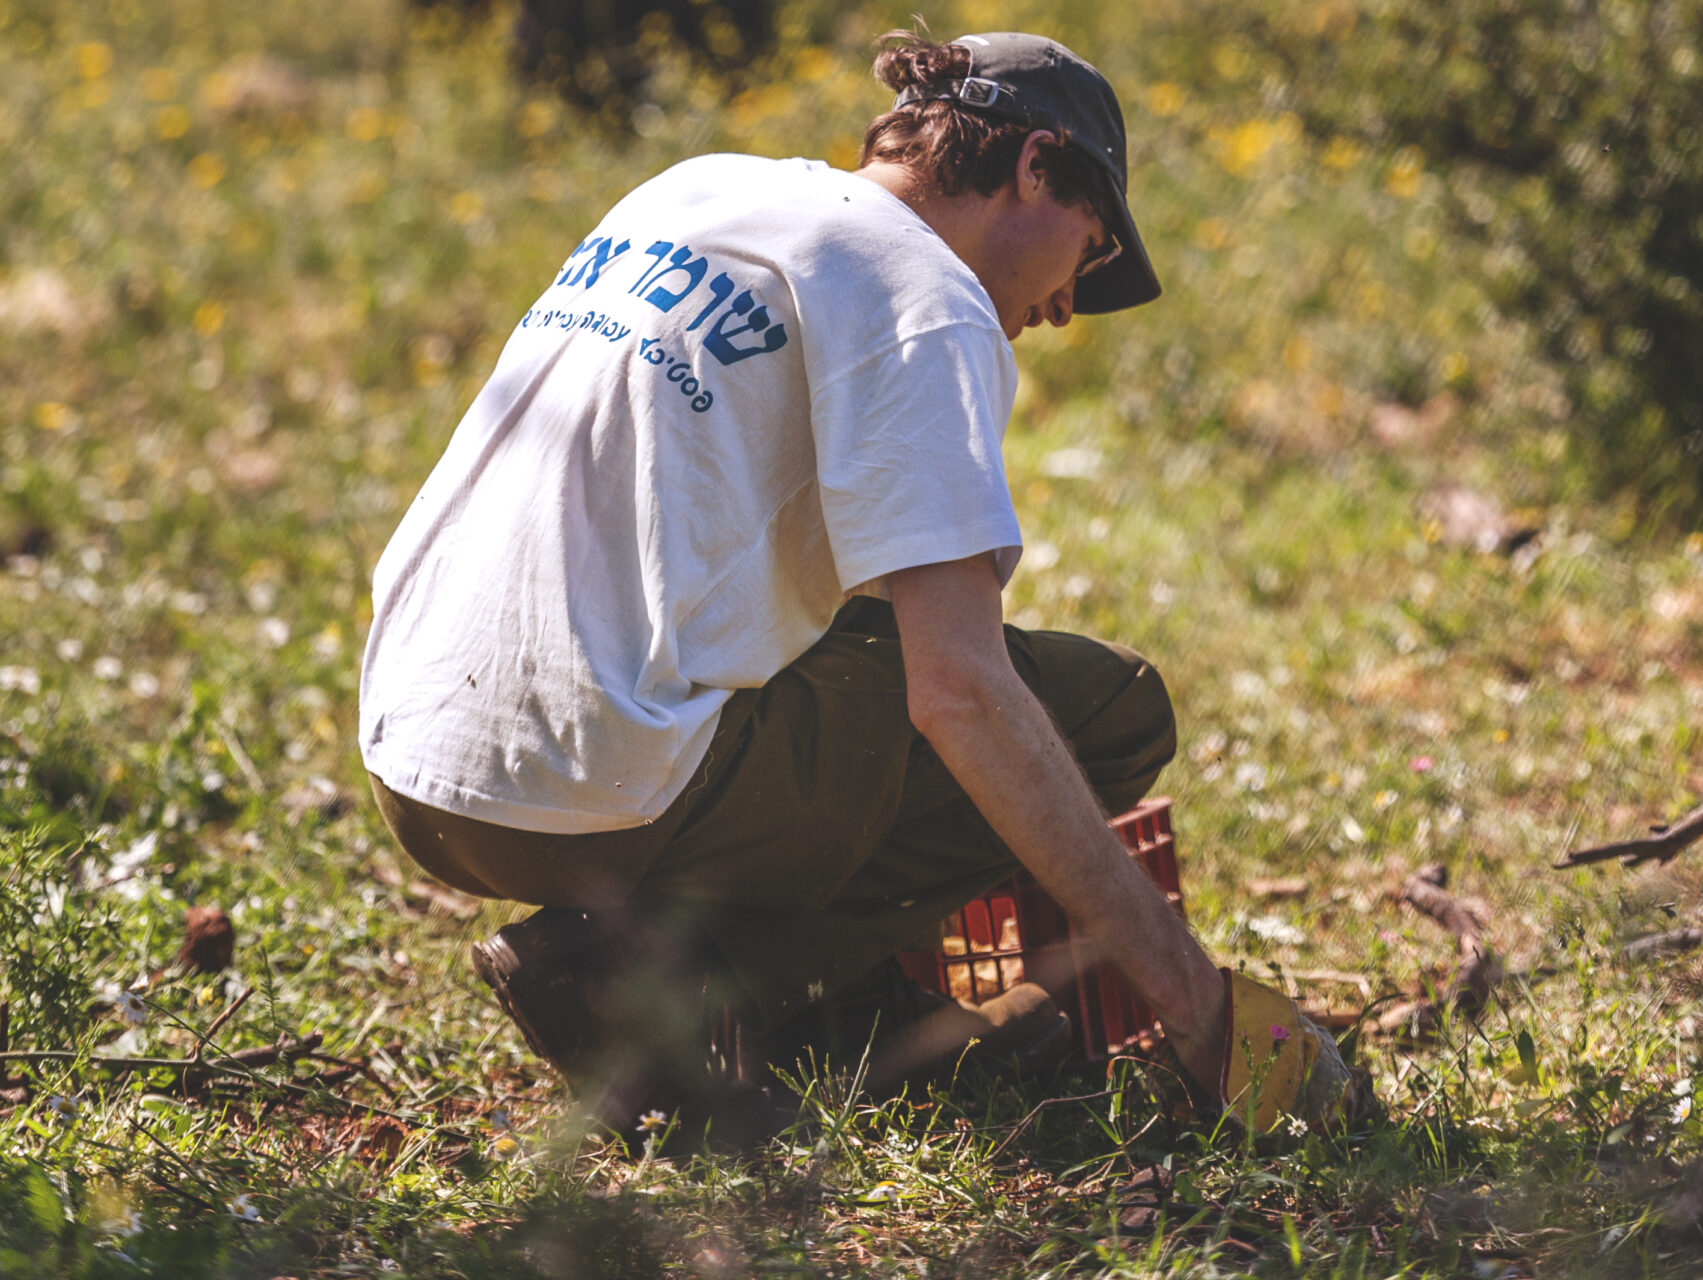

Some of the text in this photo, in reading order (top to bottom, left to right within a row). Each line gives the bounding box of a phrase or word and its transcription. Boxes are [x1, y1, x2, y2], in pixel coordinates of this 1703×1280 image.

[580, 310, 632, 343] עבודה
[628, 240, 788, 366] שומר
[639, 337, 714, 413] פסטיבל
